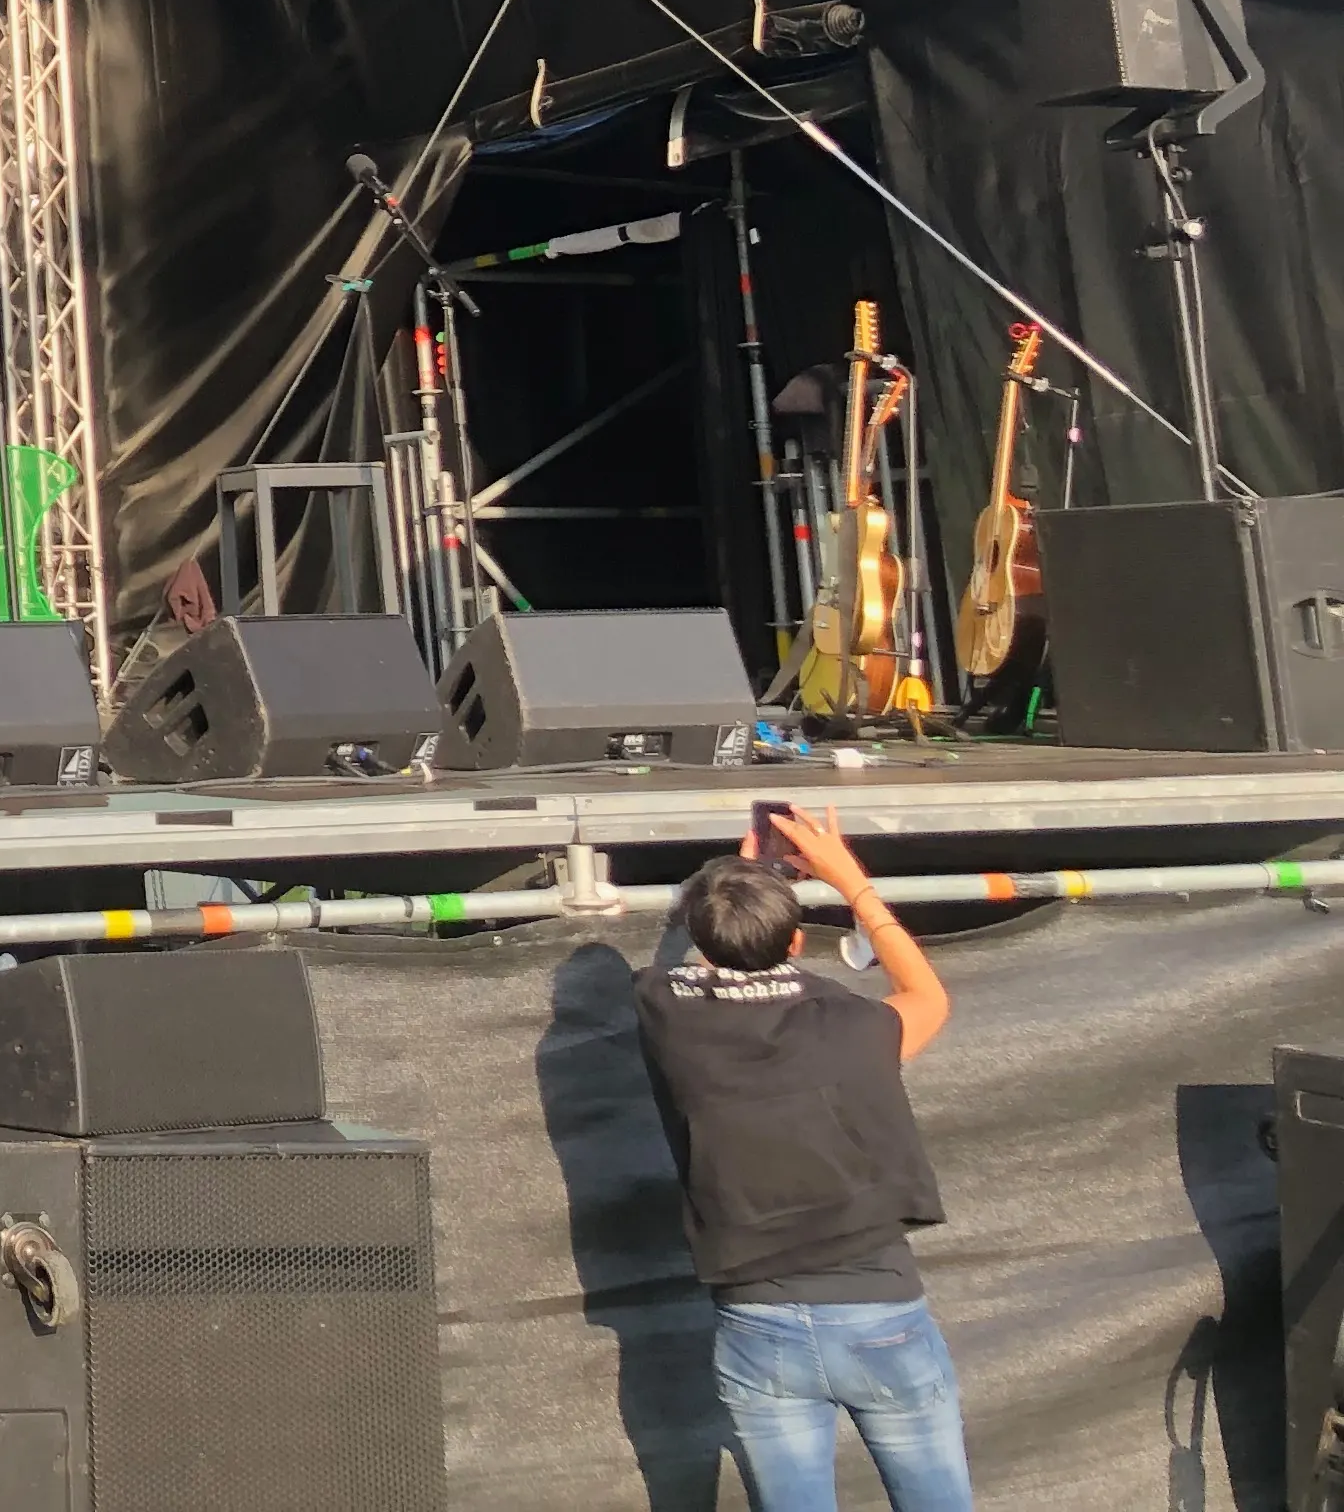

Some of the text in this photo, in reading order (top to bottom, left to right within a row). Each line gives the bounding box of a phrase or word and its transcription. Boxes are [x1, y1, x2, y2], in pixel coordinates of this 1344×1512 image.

[734, 726, 750, 754] TDA
[77, 748, 92, 779] TDA
[713, 755, 744, 767] Live
[670, 979, 802, 1000] the machine
